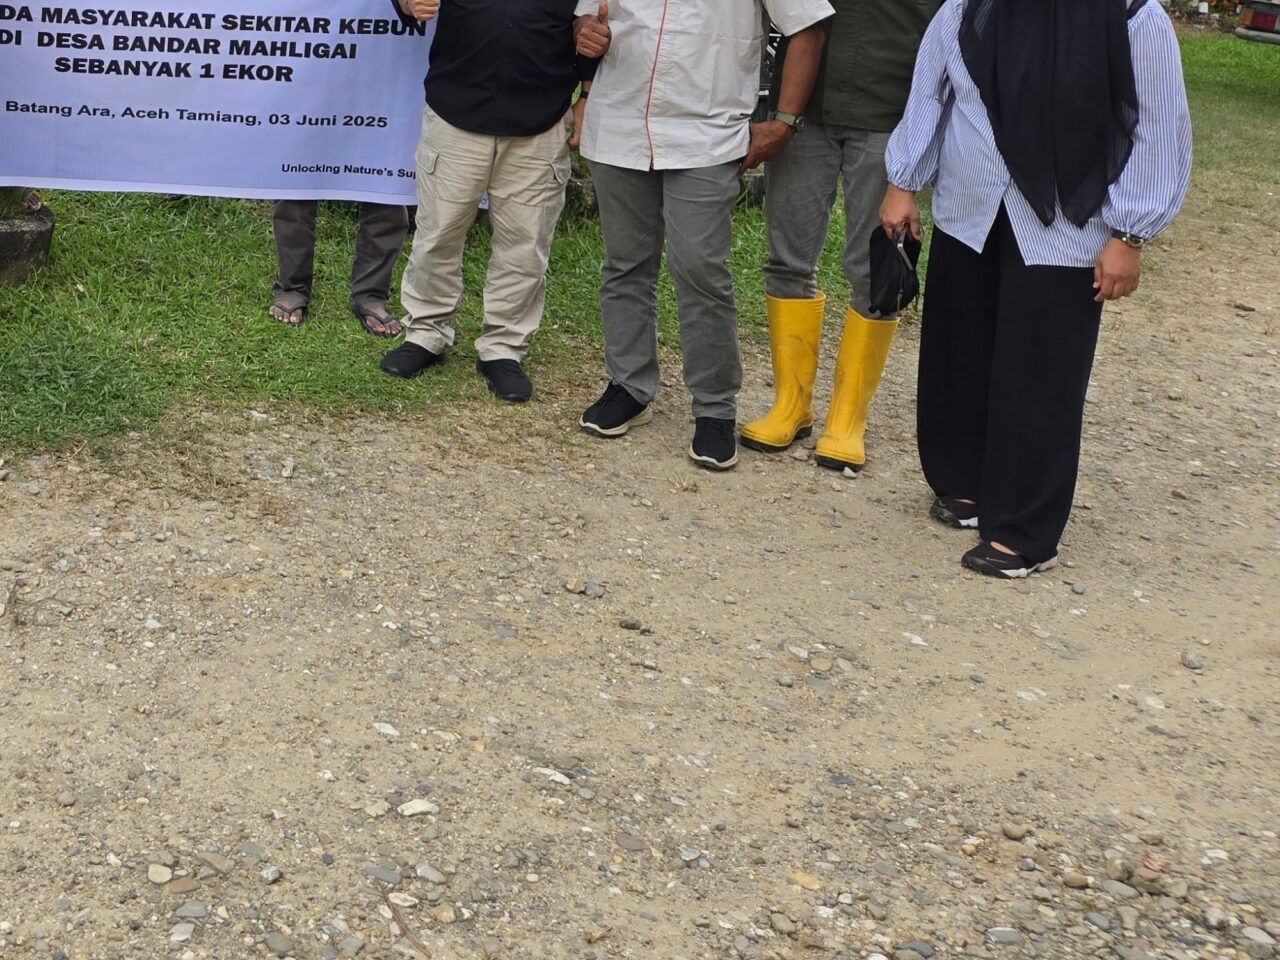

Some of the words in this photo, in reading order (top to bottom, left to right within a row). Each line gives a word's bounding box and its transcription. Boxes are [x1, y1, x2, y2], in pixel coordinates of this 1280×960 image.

[41, 8, 215, 29] MASYARAKAT
[222, 15, 330, 33] SEKITAR
[339, 19, 426, 36] KEBUN
[38, 32, 104, 49] DESA
[113, 36, 220, 54] BANDAR
[229, 40, 356, 58] MAHLIGAI
[55, 58, 191, 77] SEBANYAK
[200, 64, 214, 78] 1
[223, 65, 293, 81] EKOR
[6, 101, 72, 117] Batang
[77, 104, 115, 119] Ara,
[122, 107, 169, 119] Aceh
[176, 109, 262, 127] Tamiang,
[269, 114, 290, 125] 03
[296, 114, 337, 127] Juni
[343, 116, 388, 128] 2025
[282, 164, 340, 175] Unlocking
[344, 165, 393, 177] Nature's
